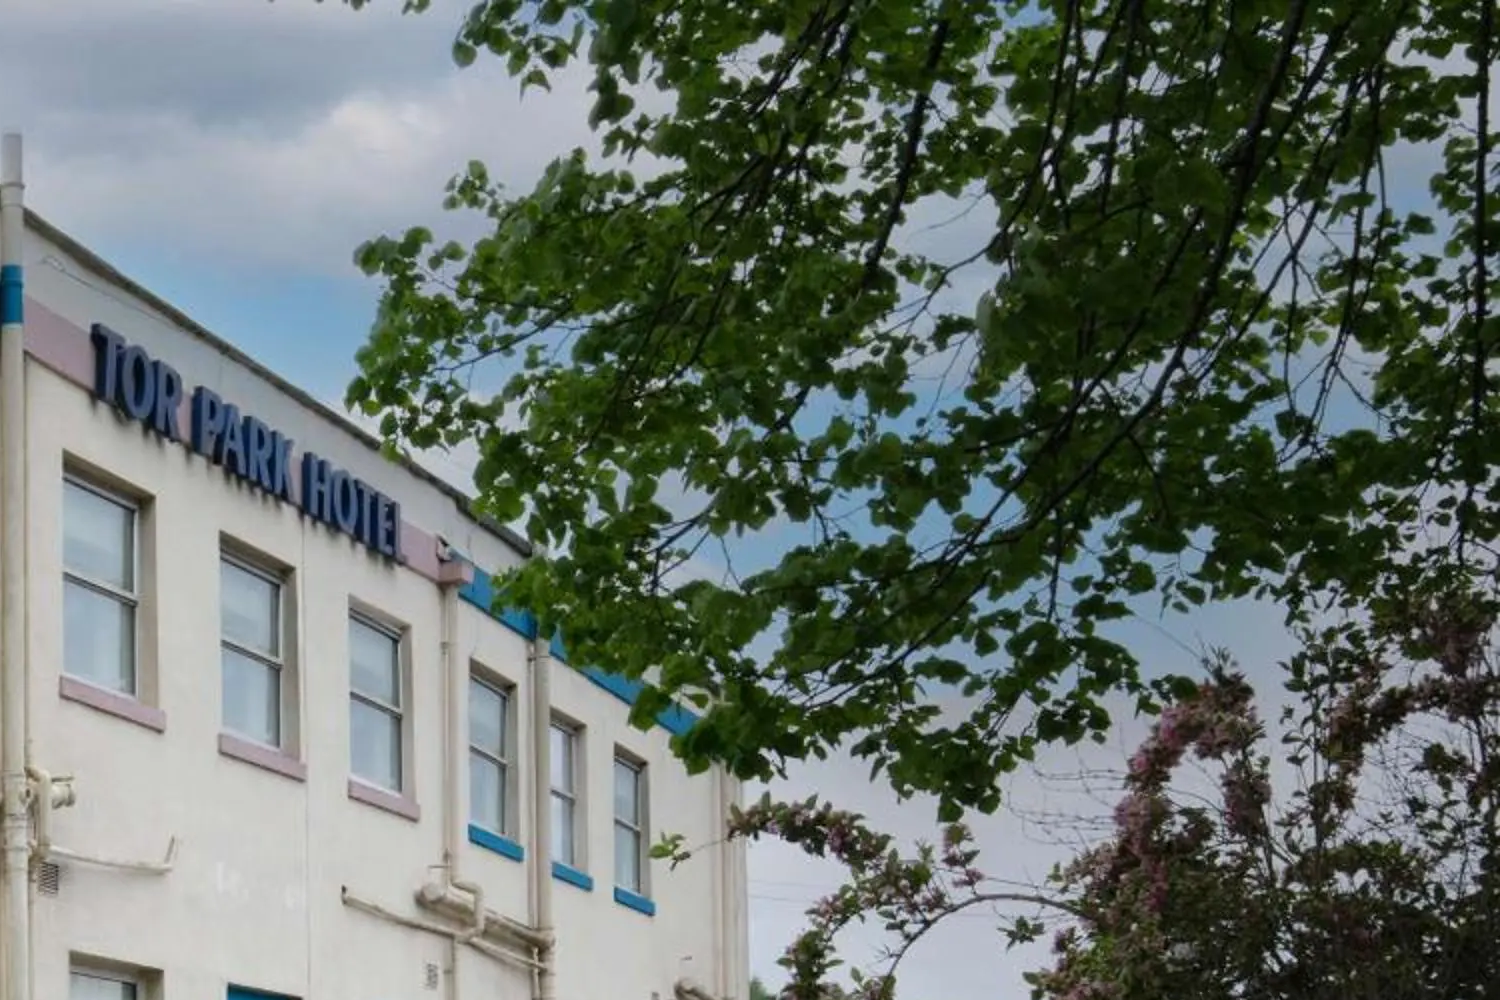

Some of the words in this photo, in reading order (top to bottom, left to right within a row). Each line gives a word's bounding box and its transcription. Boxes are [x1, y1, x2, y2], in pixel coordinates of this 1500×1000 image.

[91, 323, 183, 443] TOR
[191, 385, 294, 501] PARK
[302, 451, 402, 562] HOTEL
